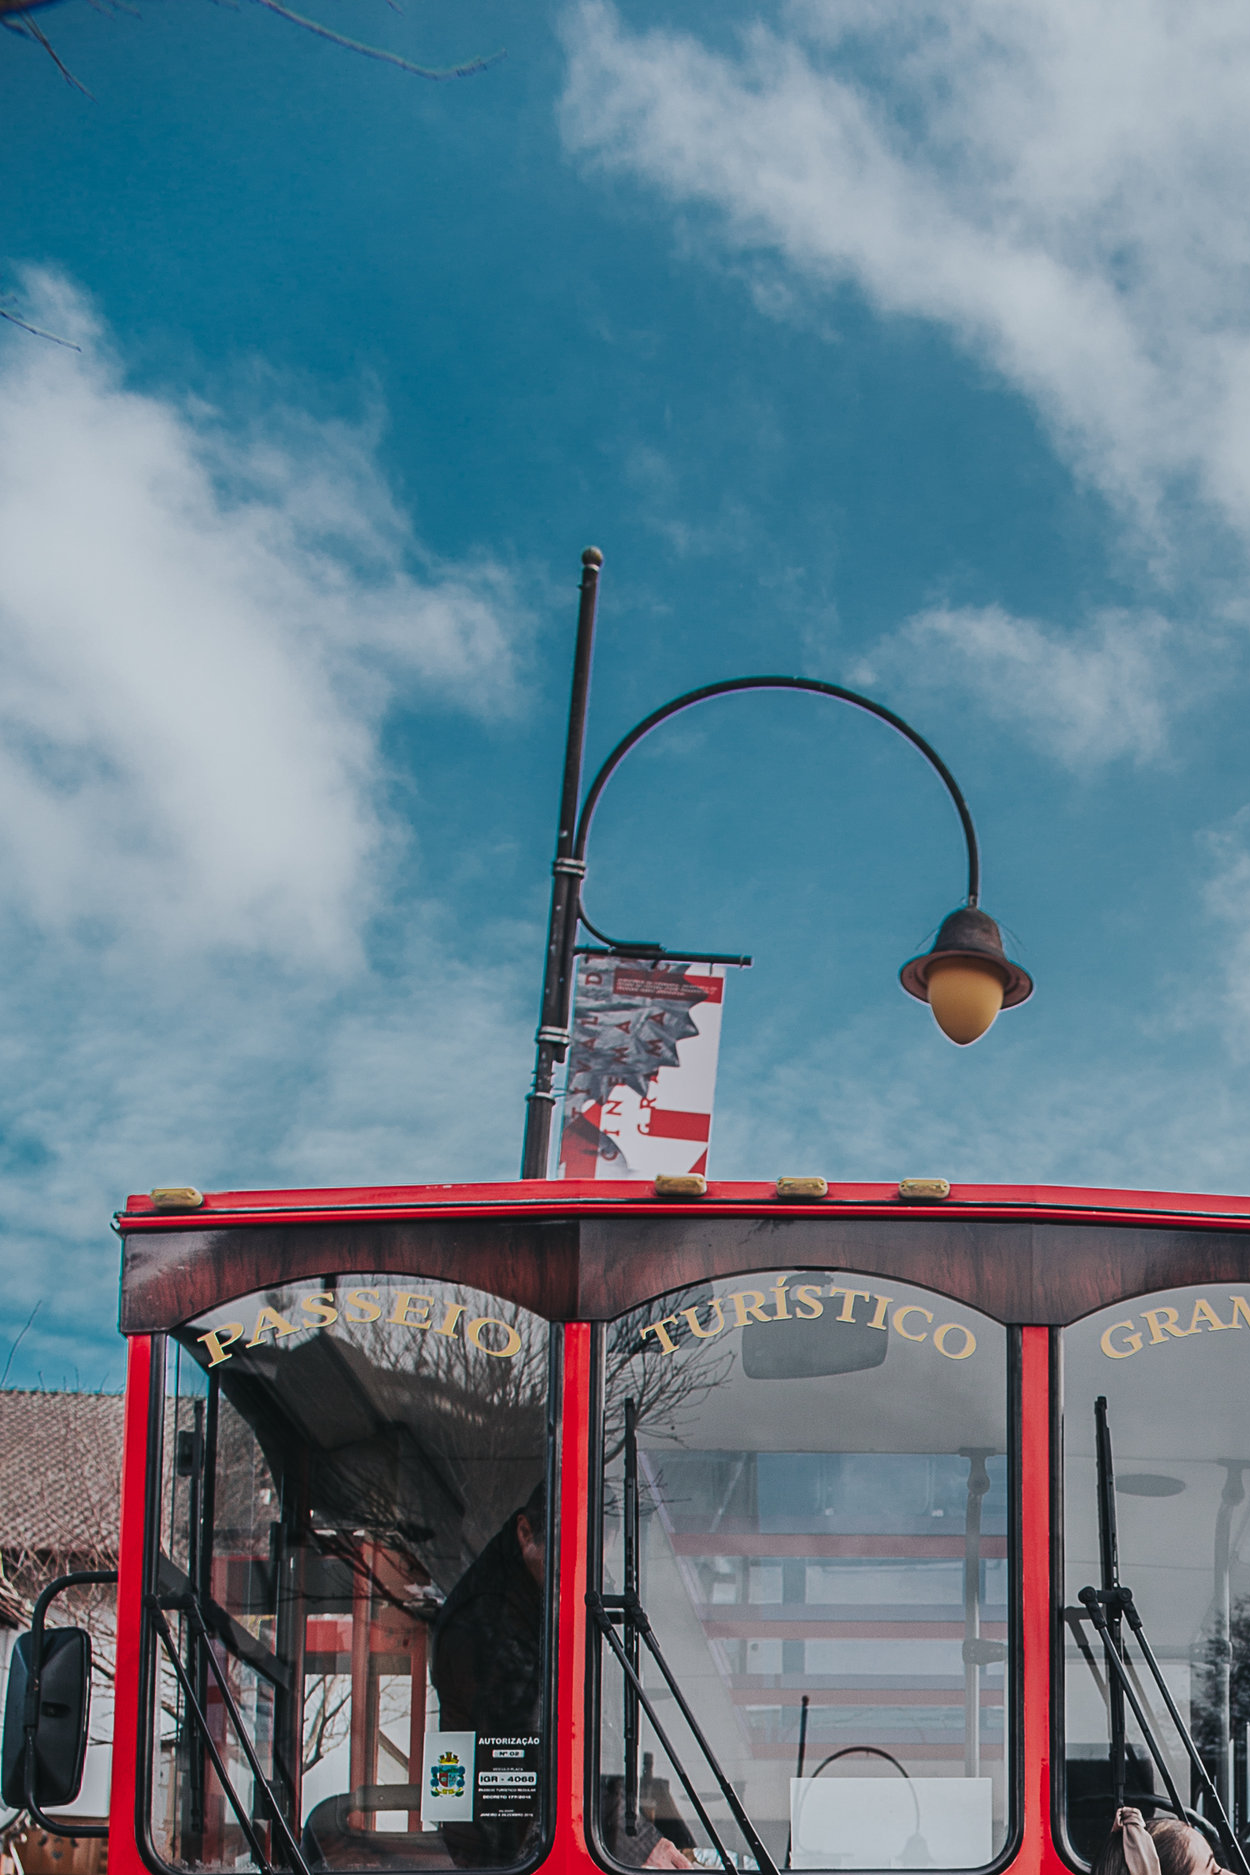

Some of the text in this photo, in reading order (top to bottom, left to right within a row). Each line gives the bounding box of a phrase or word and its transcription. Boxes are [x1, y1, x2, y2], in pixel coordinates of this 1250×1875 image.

[601, 1021, 632, 1160] CINEMA
[197, 1289, 522, 1368] PASSEIO
[640, 1276, 977, 1360] TURÍSTICO
[478, 1737, 540, 1746] AUTORIZAÇÃO
